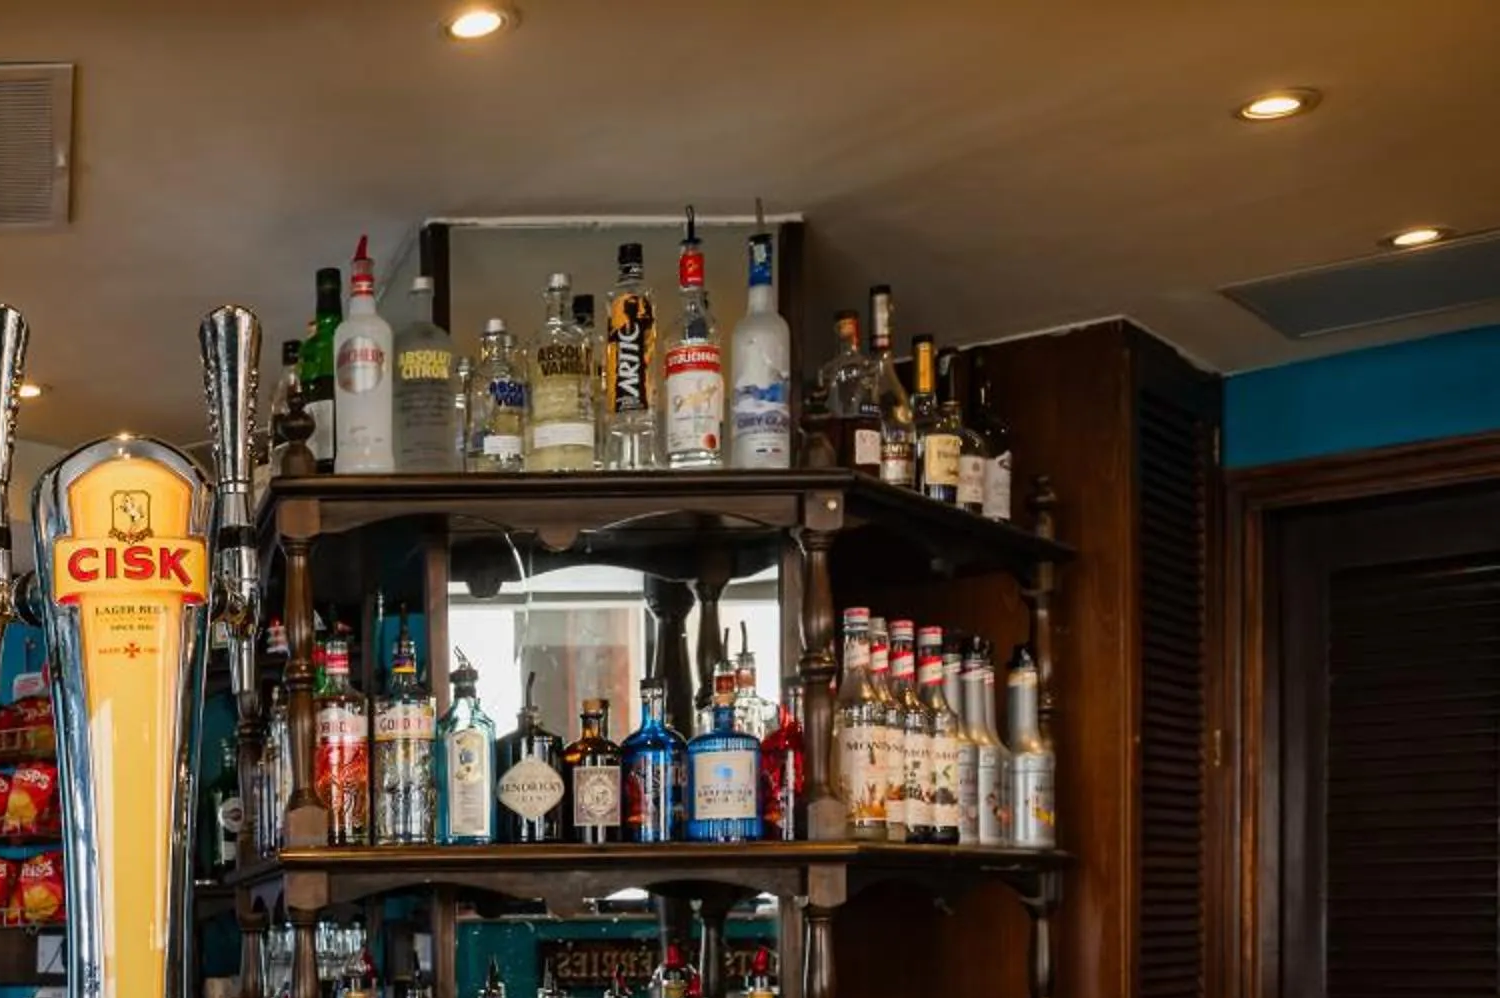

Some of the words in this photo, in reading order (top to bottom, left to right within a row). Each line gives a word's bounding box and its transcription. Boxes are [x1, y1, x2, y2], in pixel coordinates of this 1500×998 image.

[399, 350, 452, 366] ABSOLUT
[401, 362, 450, 380] CITRON
[67, 546, 192, 586] CISK
